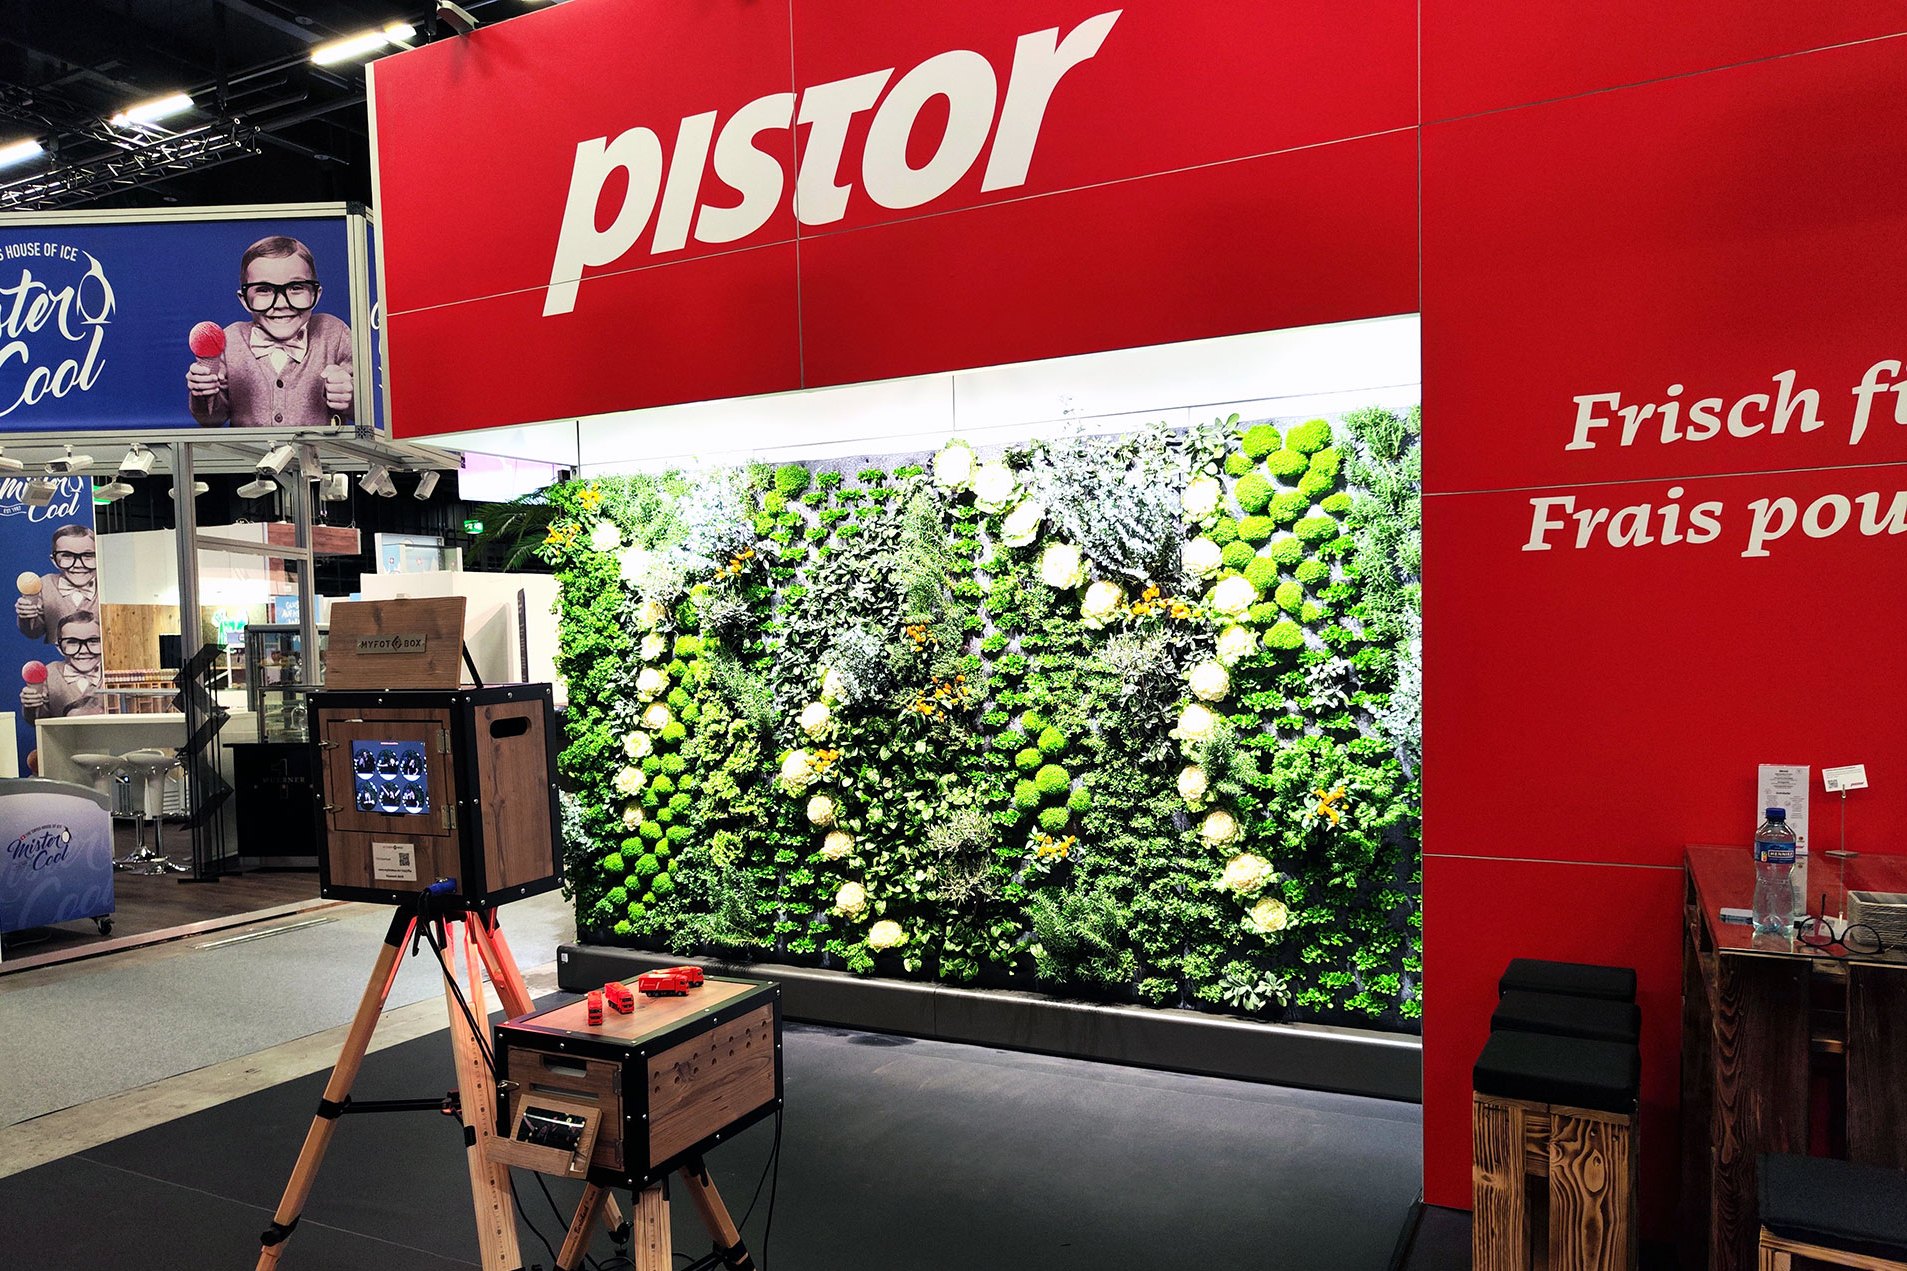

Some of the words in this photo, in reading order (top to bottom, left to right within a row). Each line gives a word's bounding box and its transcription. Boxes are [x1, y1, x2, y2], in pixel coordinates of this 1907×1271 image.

[542, 9, 1124, 317] pistor
[5, 242, 41, 259] HOUSE
[44, 242, 58, 257] OF
[59, 244, 79, 262] ICE
[1565, 369, 1825, 451] Frisch
[1521, 486, 1724, 552] Frais
[1740, 490, 1907, 558] pou
[33, 844, 69, 871] Cool
